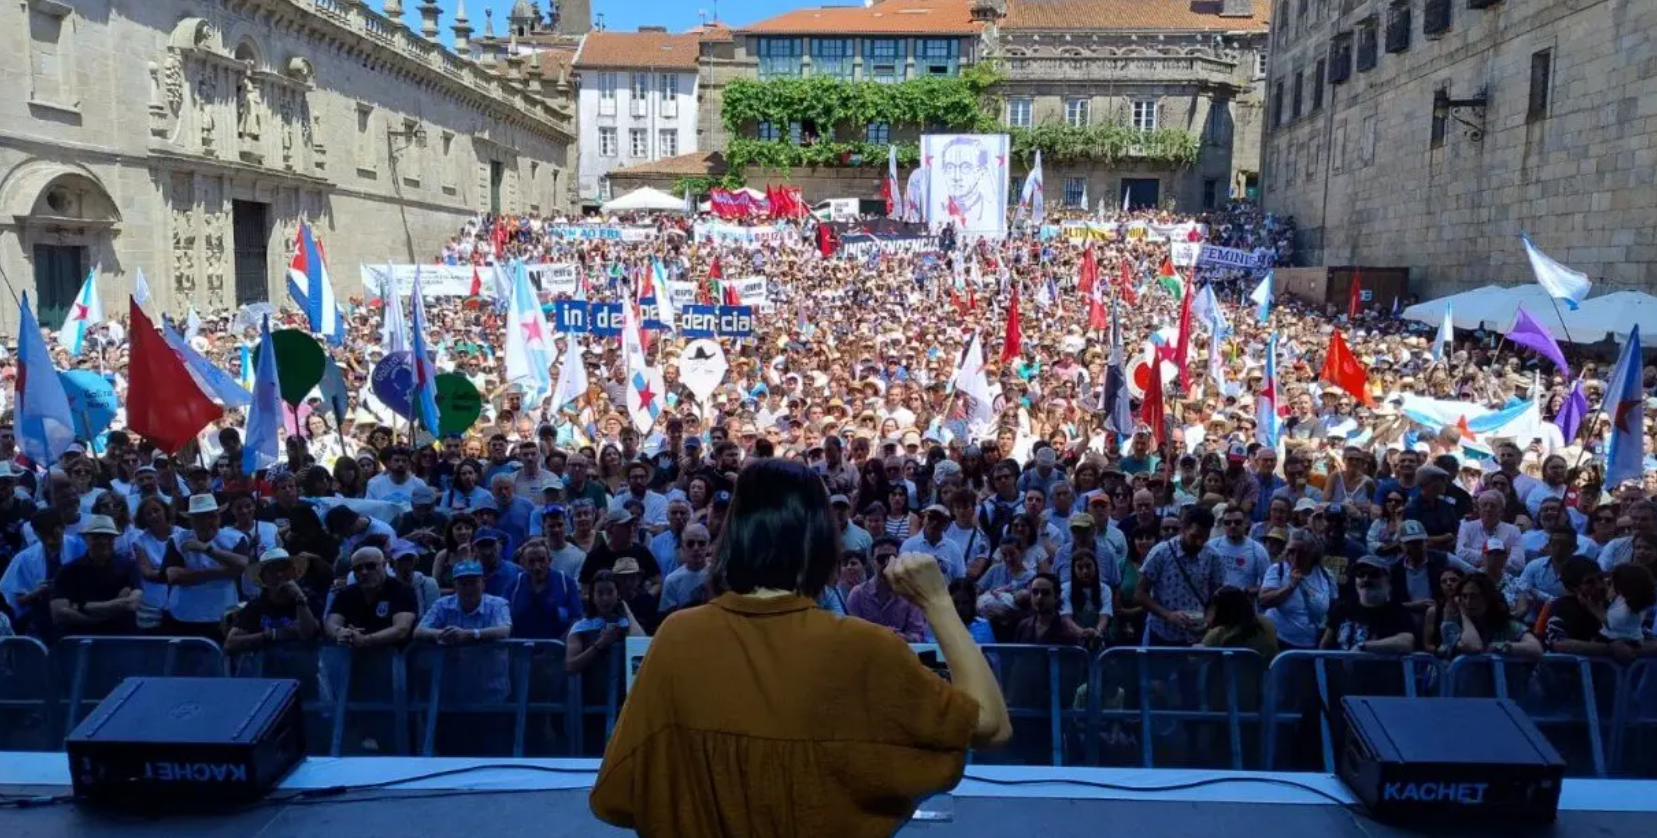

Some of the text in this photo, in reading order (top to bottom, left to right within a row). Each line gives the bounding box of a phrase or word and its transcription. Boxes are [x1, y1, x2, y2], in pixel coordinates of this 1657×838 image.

[843, 237, 940, 258] INDEPENDENCIA
[1202, 243, 1271, 267] FEMINIS
[563, 304, 583, 326] in
[640, 303, 660, 321] pe
[682, 305, 715, 331] den
[720, 310, 751, 332] cia
[145, 761, 247, 783] KACHET
[1383, 780, 1489, 804] KACHET
